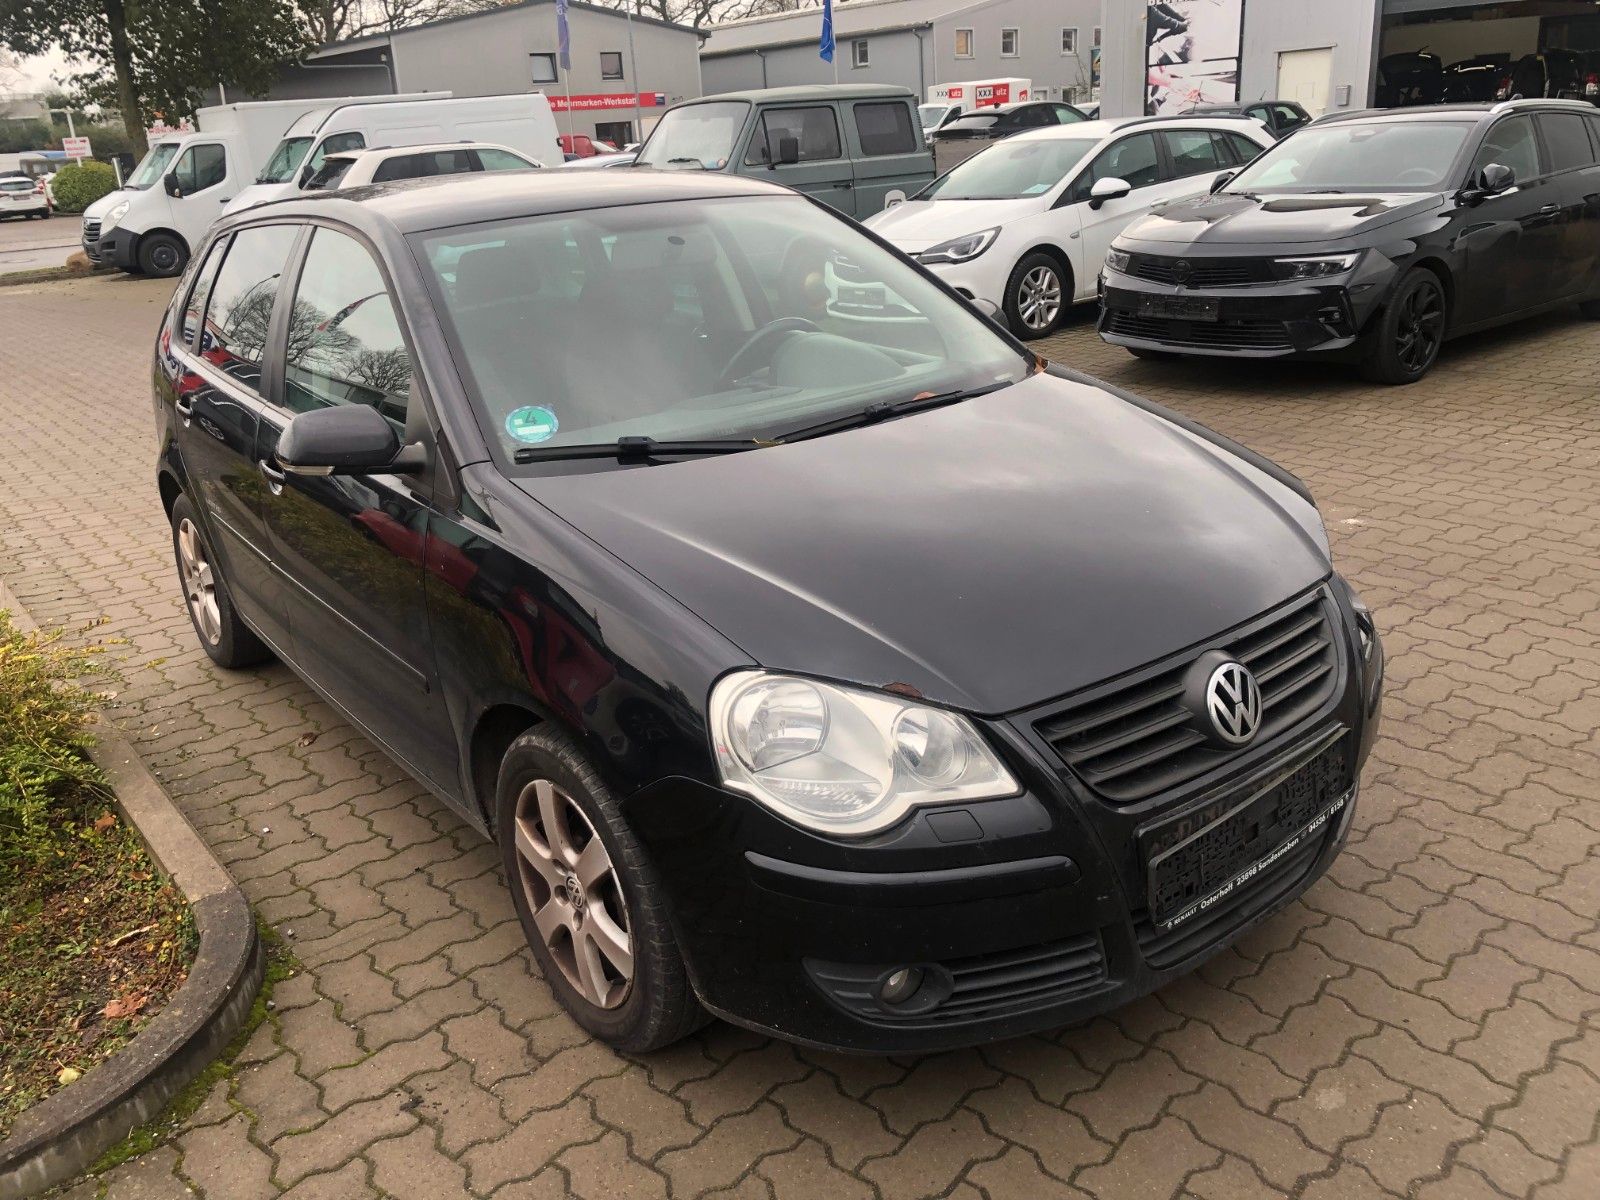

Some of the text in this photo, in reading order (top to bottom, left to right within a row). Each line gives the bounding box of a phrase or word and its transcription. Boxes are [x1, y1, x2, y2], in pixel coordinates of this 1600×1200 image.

[525, 411, 537, 425] 4
[1174, 906, 1197, 925] RENAULT
[1200, 882, 1233, 909] Osterhoff
[1236, 866, 1257, 886] 23898
